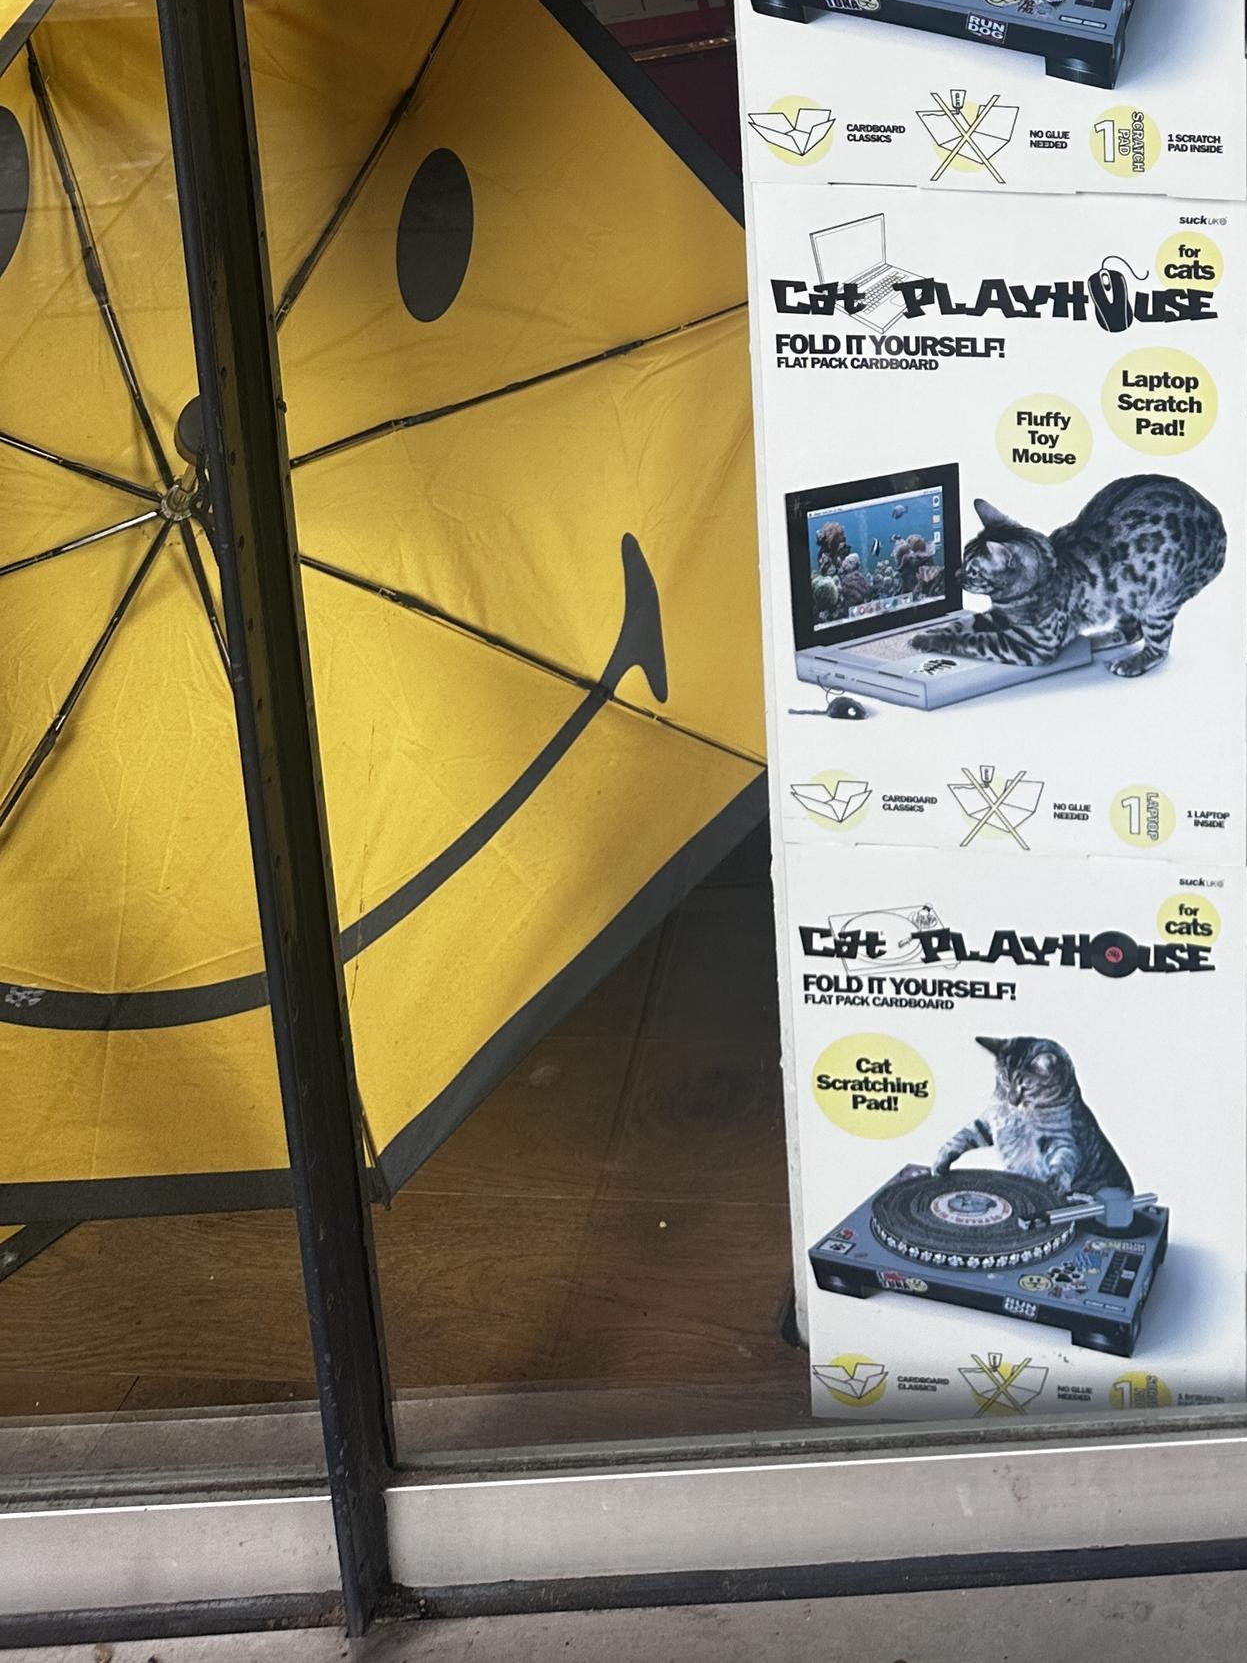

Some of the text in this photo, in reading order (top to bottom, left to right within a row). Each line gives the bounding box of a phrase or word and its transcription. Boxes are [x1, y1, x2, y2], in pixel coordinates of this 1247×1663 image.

[969, 15, 1006, 31] RUN
[968, 23, 1004, 40] DOG
[847, 123, 905, 135] CARDBOARD
[1030, 129, 1070, 140] NO GLUE
[847, 133, 892, 143] CLASSICS
[1030, 140, 1068, 149] NEEDED
[1094, 120, 1115, 163] 1
[1118, 129, 1130, 156] PAD
[1131, 111, 1145, 173] SCRATCH
[1168, 134, 1221, 145] 1 SCRATCH
[1168, 143, 1223, 154] PAD INSIDE
[1178, 244, 1200, 258] for
[1164, 260, 1215, 281] cats
[776, 334, 1005, 358] FOLD IT YOURSELF!
[777, 357, 939, 370] FLAT PACK CARDBOARD
[1121, 370, 1199, 392] Laptop
[1117, 394, 1202, 414] Scratch
[1016, 411, 1071, 431] Fluffy
[1136, 418, 1185, 437] Pad!
[1028, 430, 1058, 448] Toy
[1012, 449, 1076, 465] Mouse
[882, 795, 937, 805] CARDBOARD
[882, 803, 924, 813] CLASSICS
[1053, 803, 1091, 813] NO GLUE
[1053, 812, 1089, 821] NEEDED
[1121, 796, 1141, 835] 1
[1145, 792, 1159, 841] LAPTOP
[1187, 810, 1230, 822] 1 LAPTOP
[1194, 819, 1225, 828] INSIDE
[1178, 904, 1199, 917] for
[1165, 919, 1213, 937] cats
[803, 974, 1016, 1000] FOLD IT YOURSELF!
[804, 994, 954, 1010] FLAT PACK CARDBOARD
[856, 1058, 892, 1075] Cat
[817, 1074, 929, 1098] Scratching
[852, 1094, 898, 1112] Pad!
